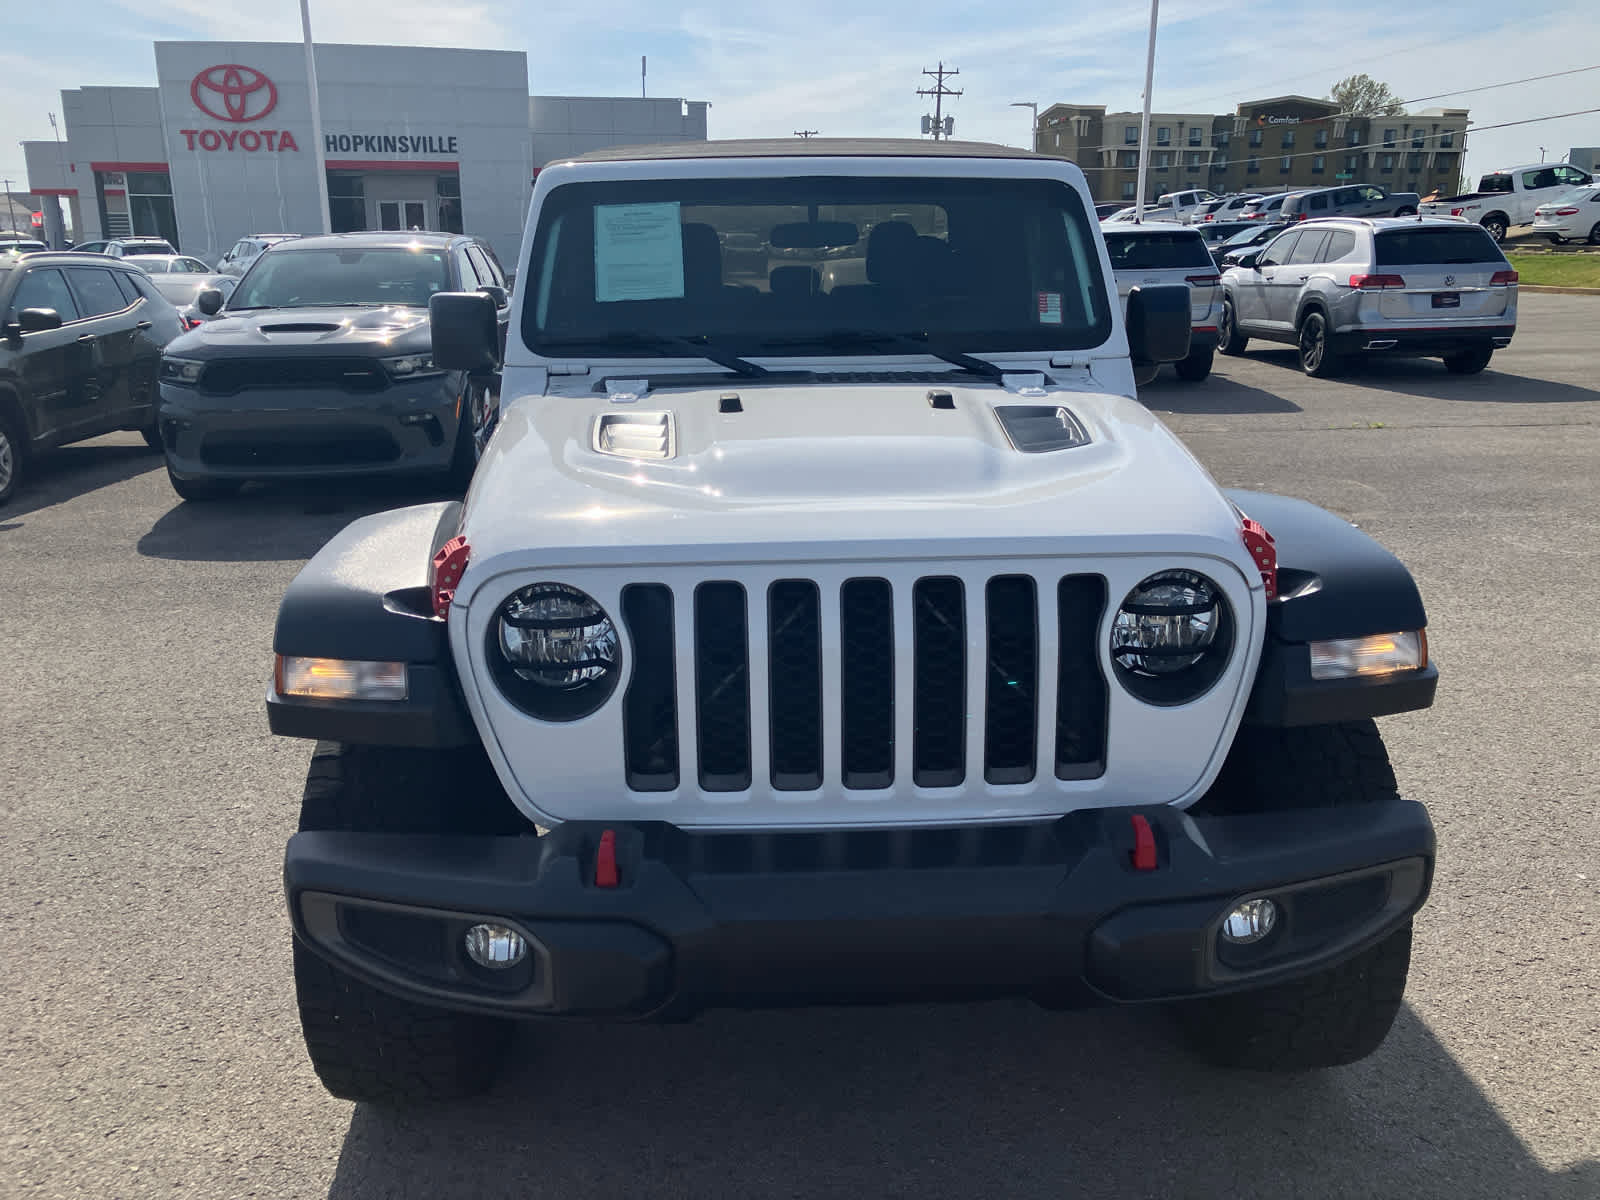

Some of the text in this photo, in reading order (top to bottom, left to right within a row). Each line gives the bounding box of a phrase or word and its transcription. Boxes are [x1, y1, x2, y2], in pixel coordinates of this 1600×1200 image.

[1268, 114, 1300, 124] Comfort
[180, 129, 298, 152] TOYOTA
[325, 134, 458, 153] HOPKINSVILLE
